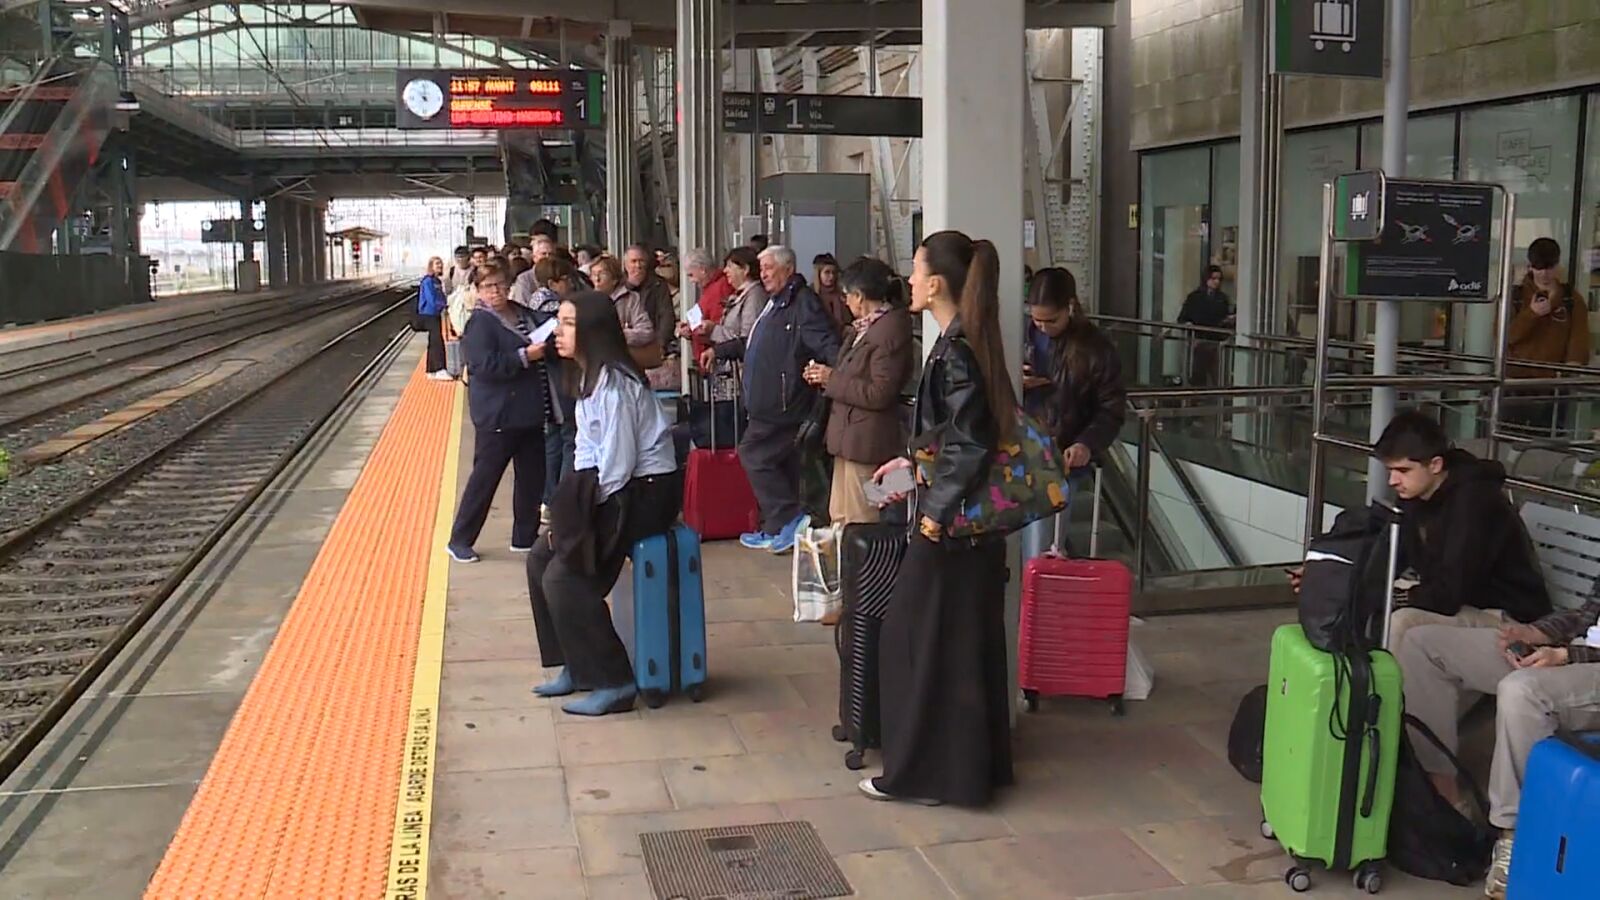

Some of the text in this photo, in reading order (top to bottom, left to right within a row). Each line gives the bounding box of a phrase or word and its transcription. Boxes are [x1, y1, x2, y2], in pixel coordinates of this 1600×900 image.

[576, 98, 585, 118] 1
[786, 98, 804, 128] 1
[406, 767, 427, 803] AGARDE
[400, 843, 420, 856] LA
[397, 859, 420, 874] DE
